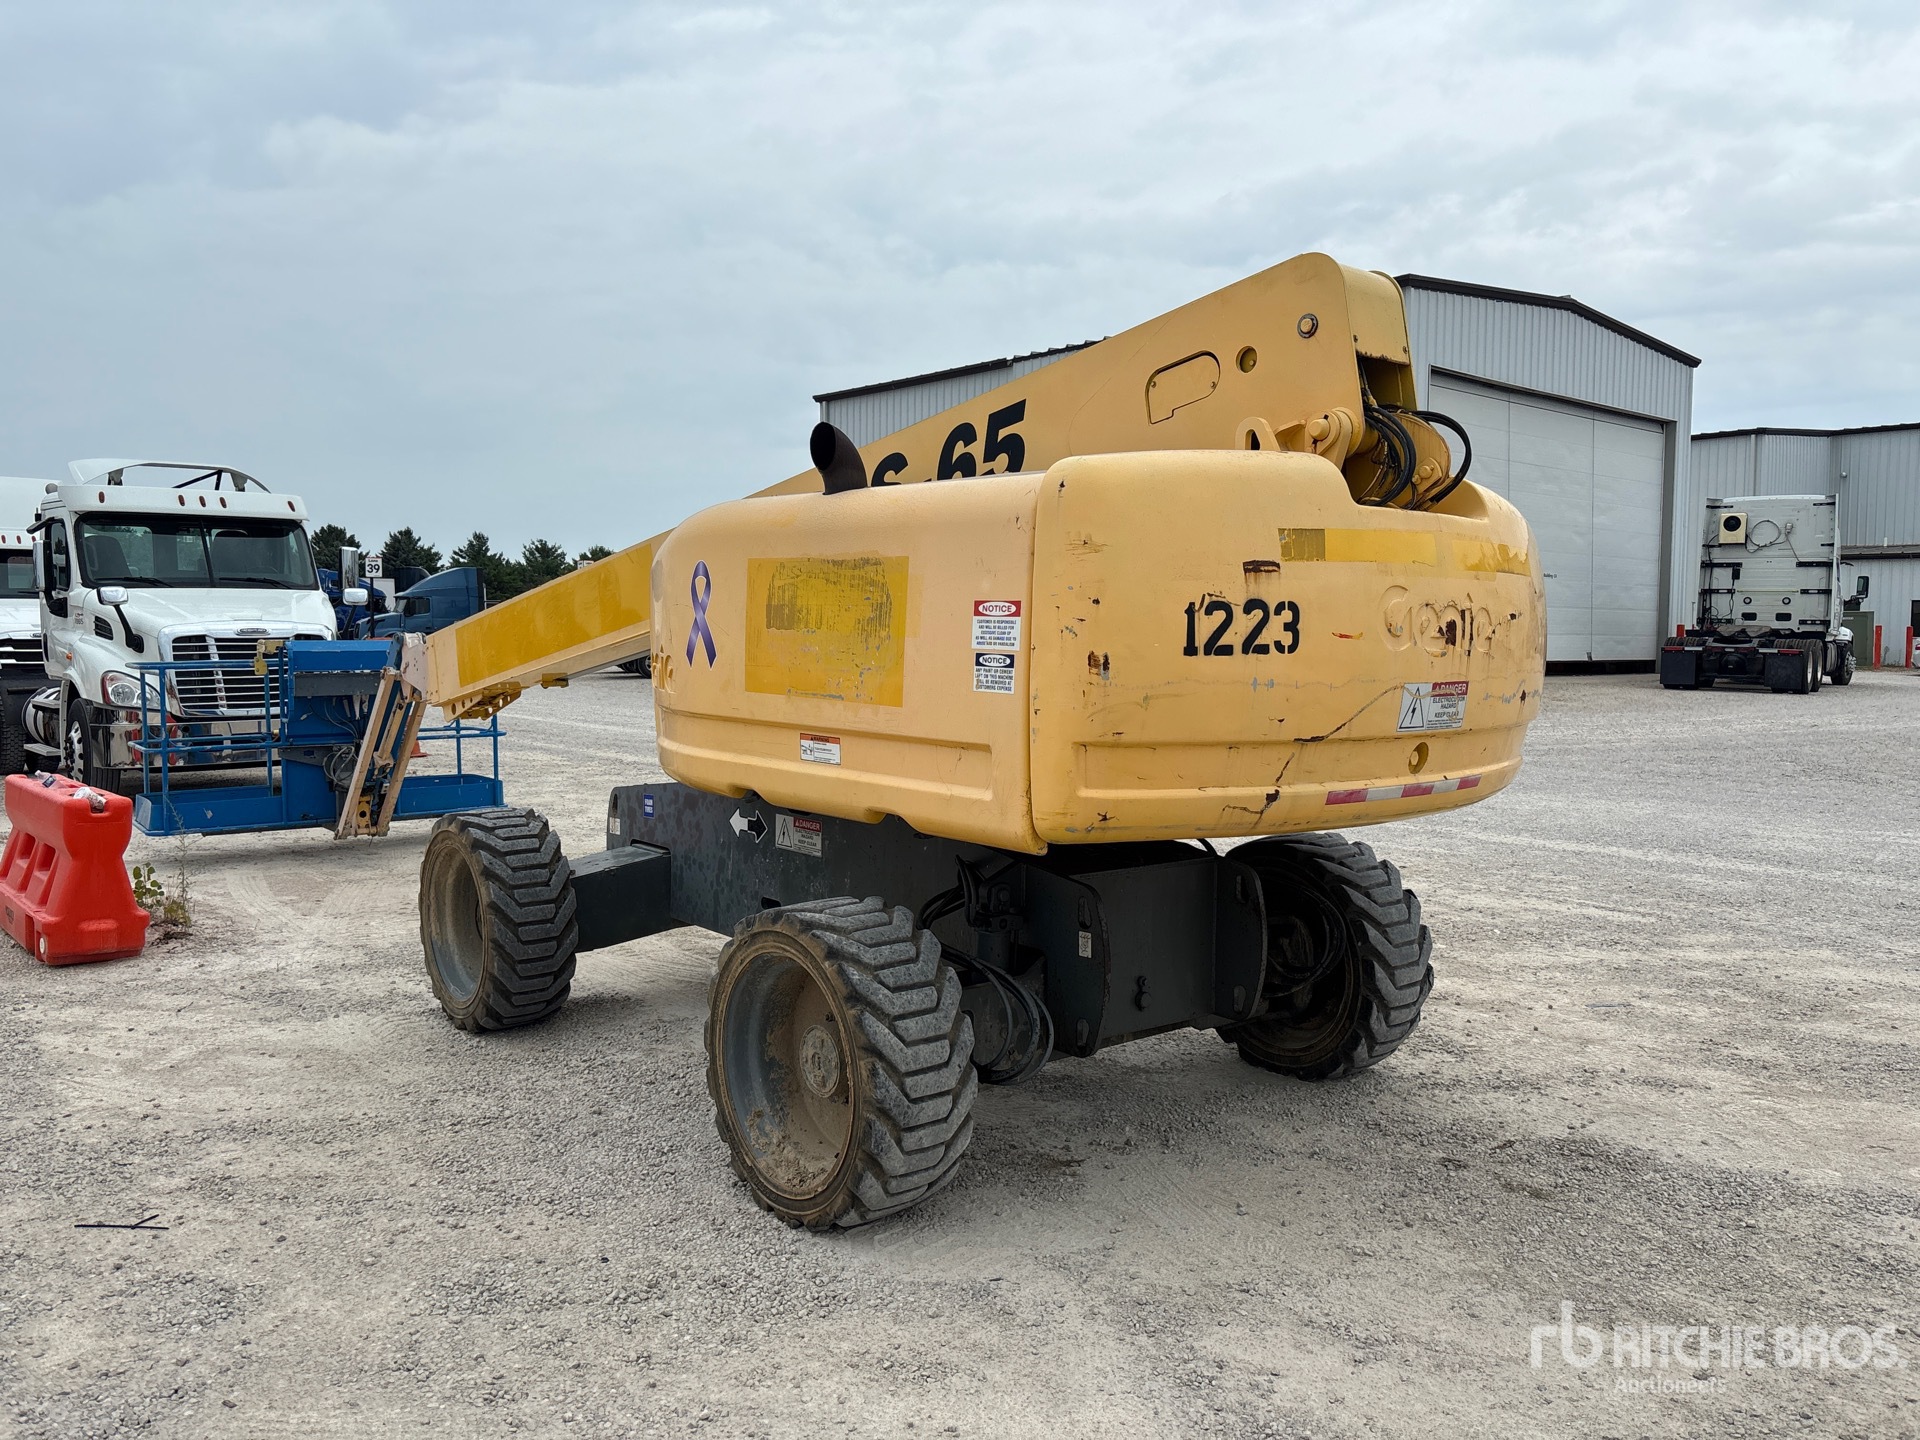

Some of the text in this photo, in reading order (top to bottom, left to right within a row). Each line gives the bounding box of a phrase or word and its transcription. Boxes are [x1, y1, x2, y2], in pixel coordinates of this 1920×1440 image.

[367, 564, 380, 573] 39
[1183, 598, 1300, 656] 1223
[982, 656, 1008, 665] NOTICE
[1440, 683, 1467, 693] DANGER
[1432, 696, 1466, 704] ELECTROCION
[799, 819, 821, 831] DANGER
[801, 833, 814, 841] HAZARD
